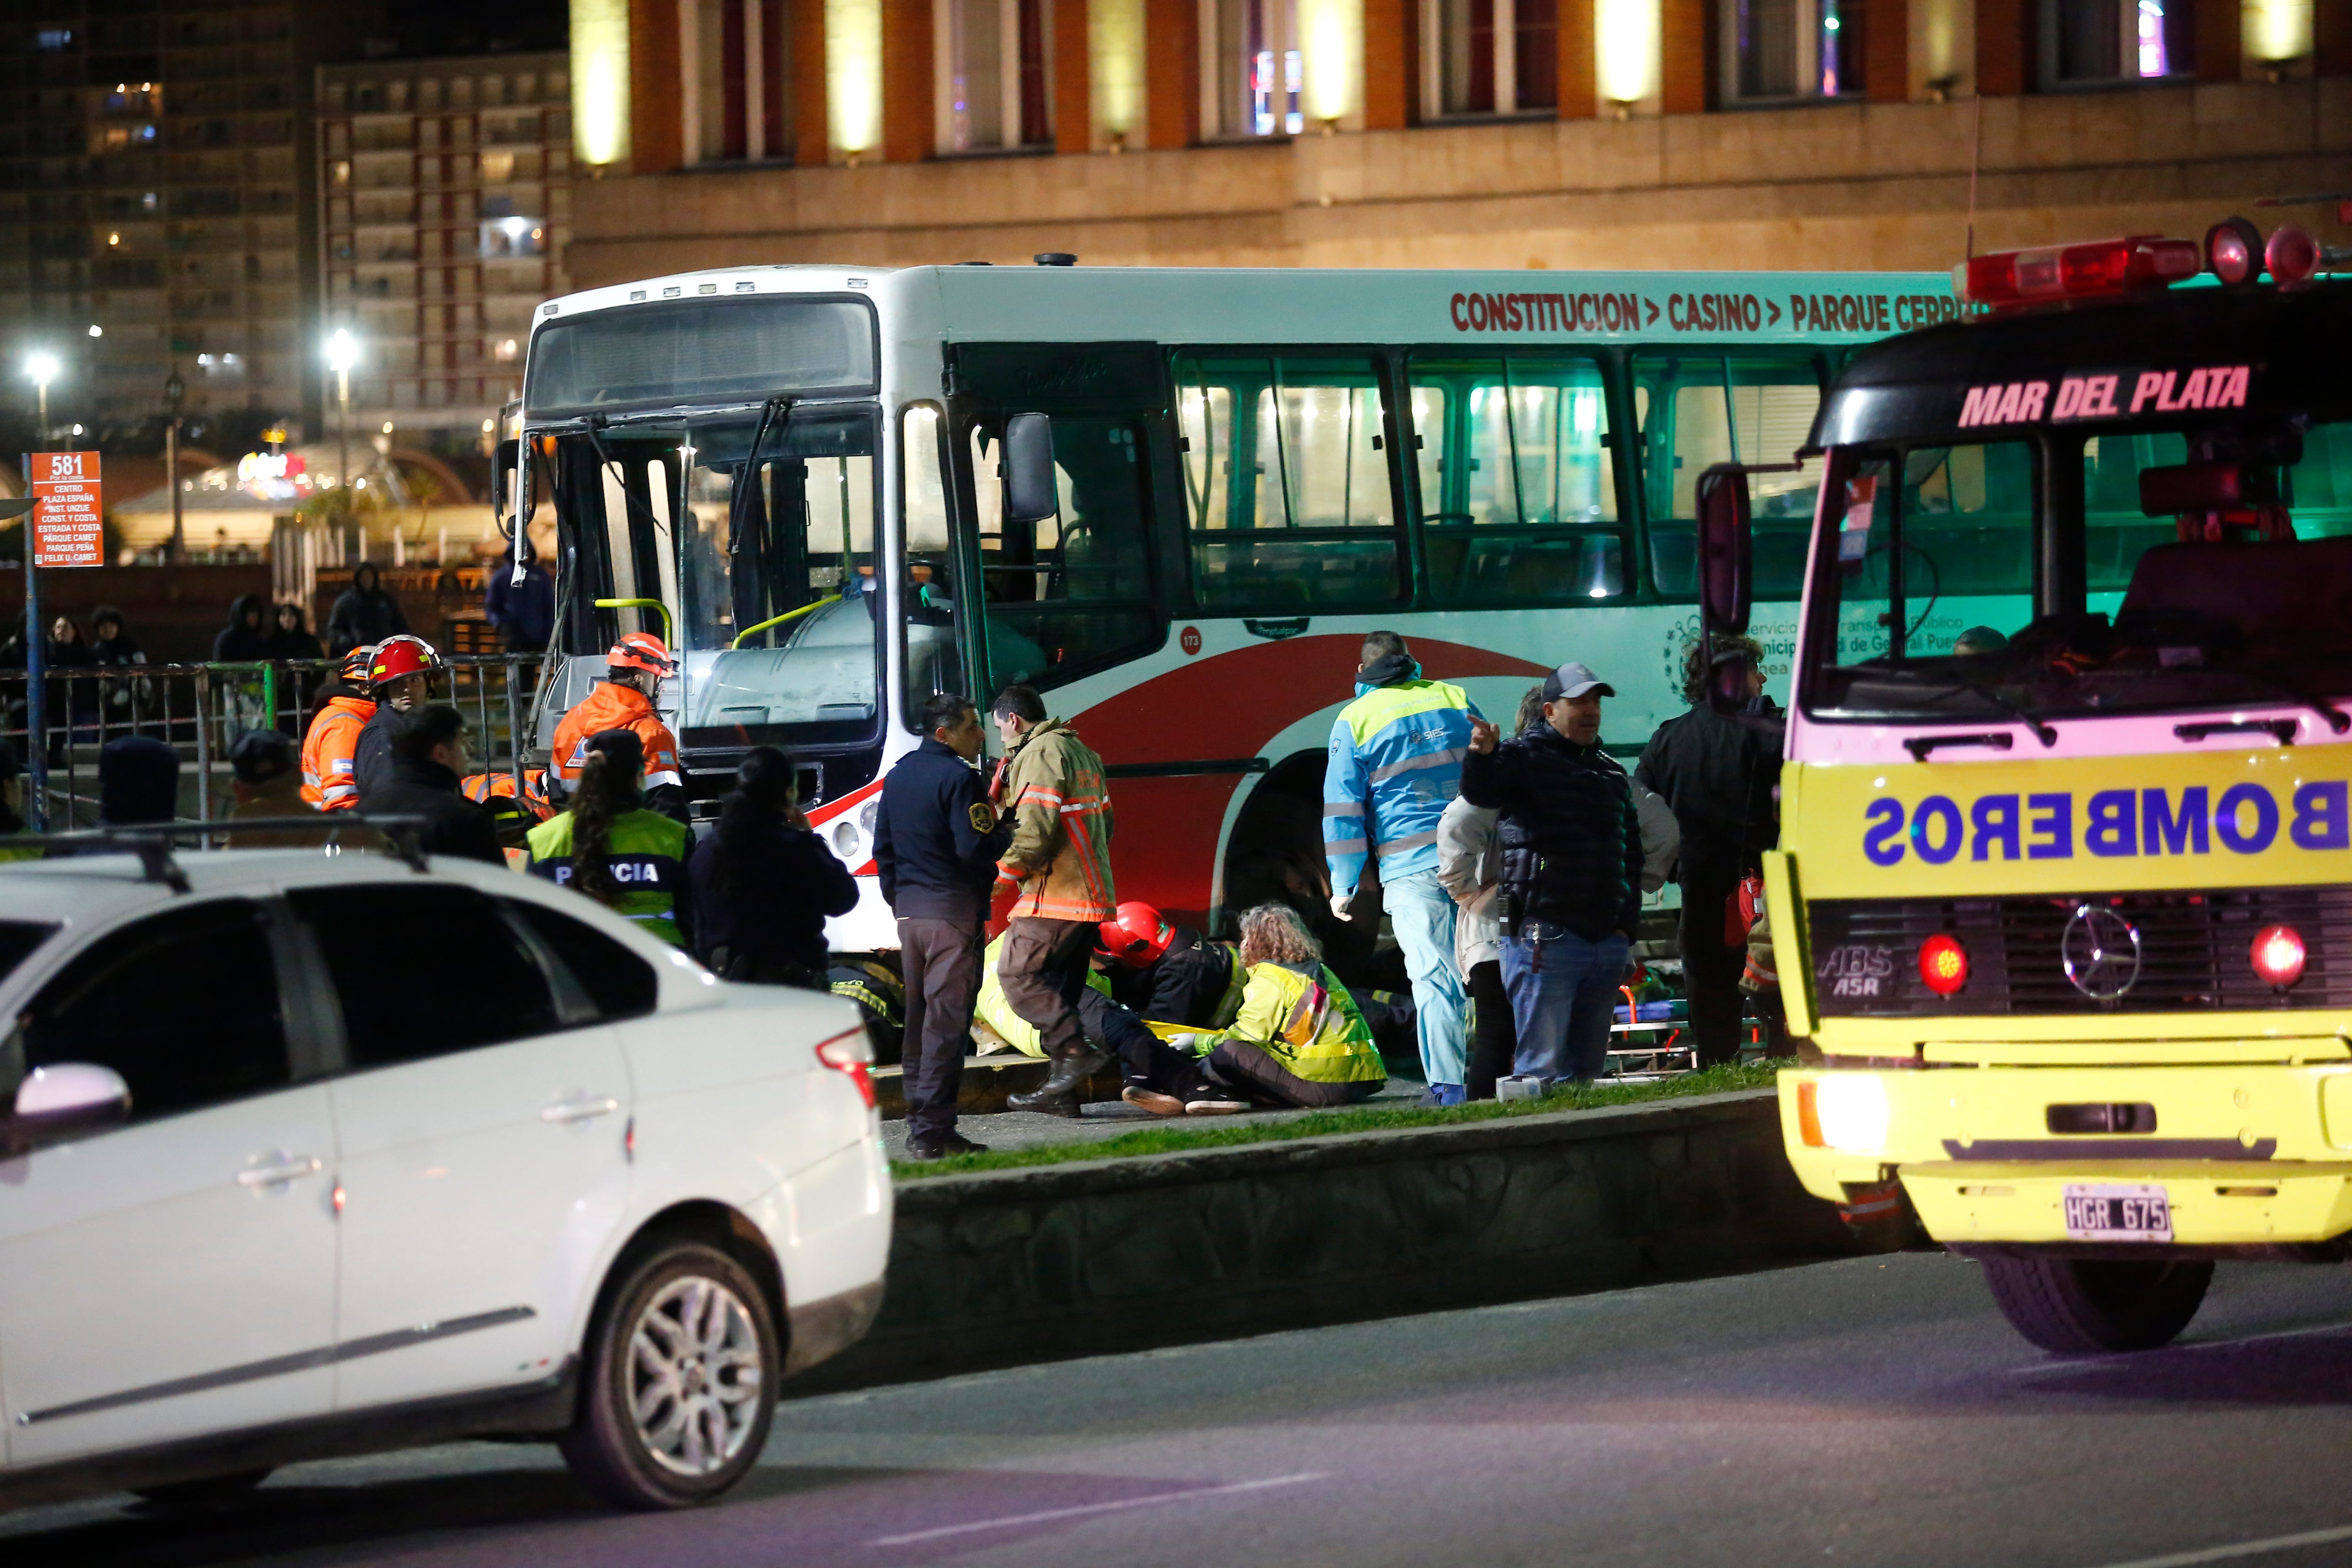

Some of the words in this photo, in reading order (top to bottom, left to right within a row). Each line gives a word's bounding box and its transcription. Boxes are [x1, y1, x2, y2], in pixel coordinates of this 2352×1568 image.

[1450, 293, 1640, 332] CONSTITUCION
[1668, 293, 1761, 332] CASINO
[1790, 294, 1890, 332] PARQUE
[1957, 380, 2050, 428] MAR
[2050, 375, 2119, 419] DEL
[2129, 366, 2250, 413] PLATA
[52, 455, 82, 476] 581
[54, 485, 83, 493] CENTRO
[43, 495, 66, 503] PLAZA
[67, 493, 94, 502] ESPAÑA
[41, 515, 67, 523] CONST.
[38, 525, 72, 533] ESTRADA
[43, 534, 72, 542] PARQUE
[73, 533, 97, 541] CAMET
[46, 543, 75, 552] PARQUE
[76, 541, 95, 551] PEÑA
[73, 553, 98, 561] CAMET
[1746, 621, 1797, 636] ervicio
[1850, 636, 1867, 652] de
[1423, 727, 1444, 740] SIES
[556, 863, 659, 885] PCIA
[1817, 945, 1893, 977] ABS
[1833, 977, 1880, 996] ASR
[2067, 1198, 2110, 1229] HGR
[2122, 1198, 2167, 1230] 675
